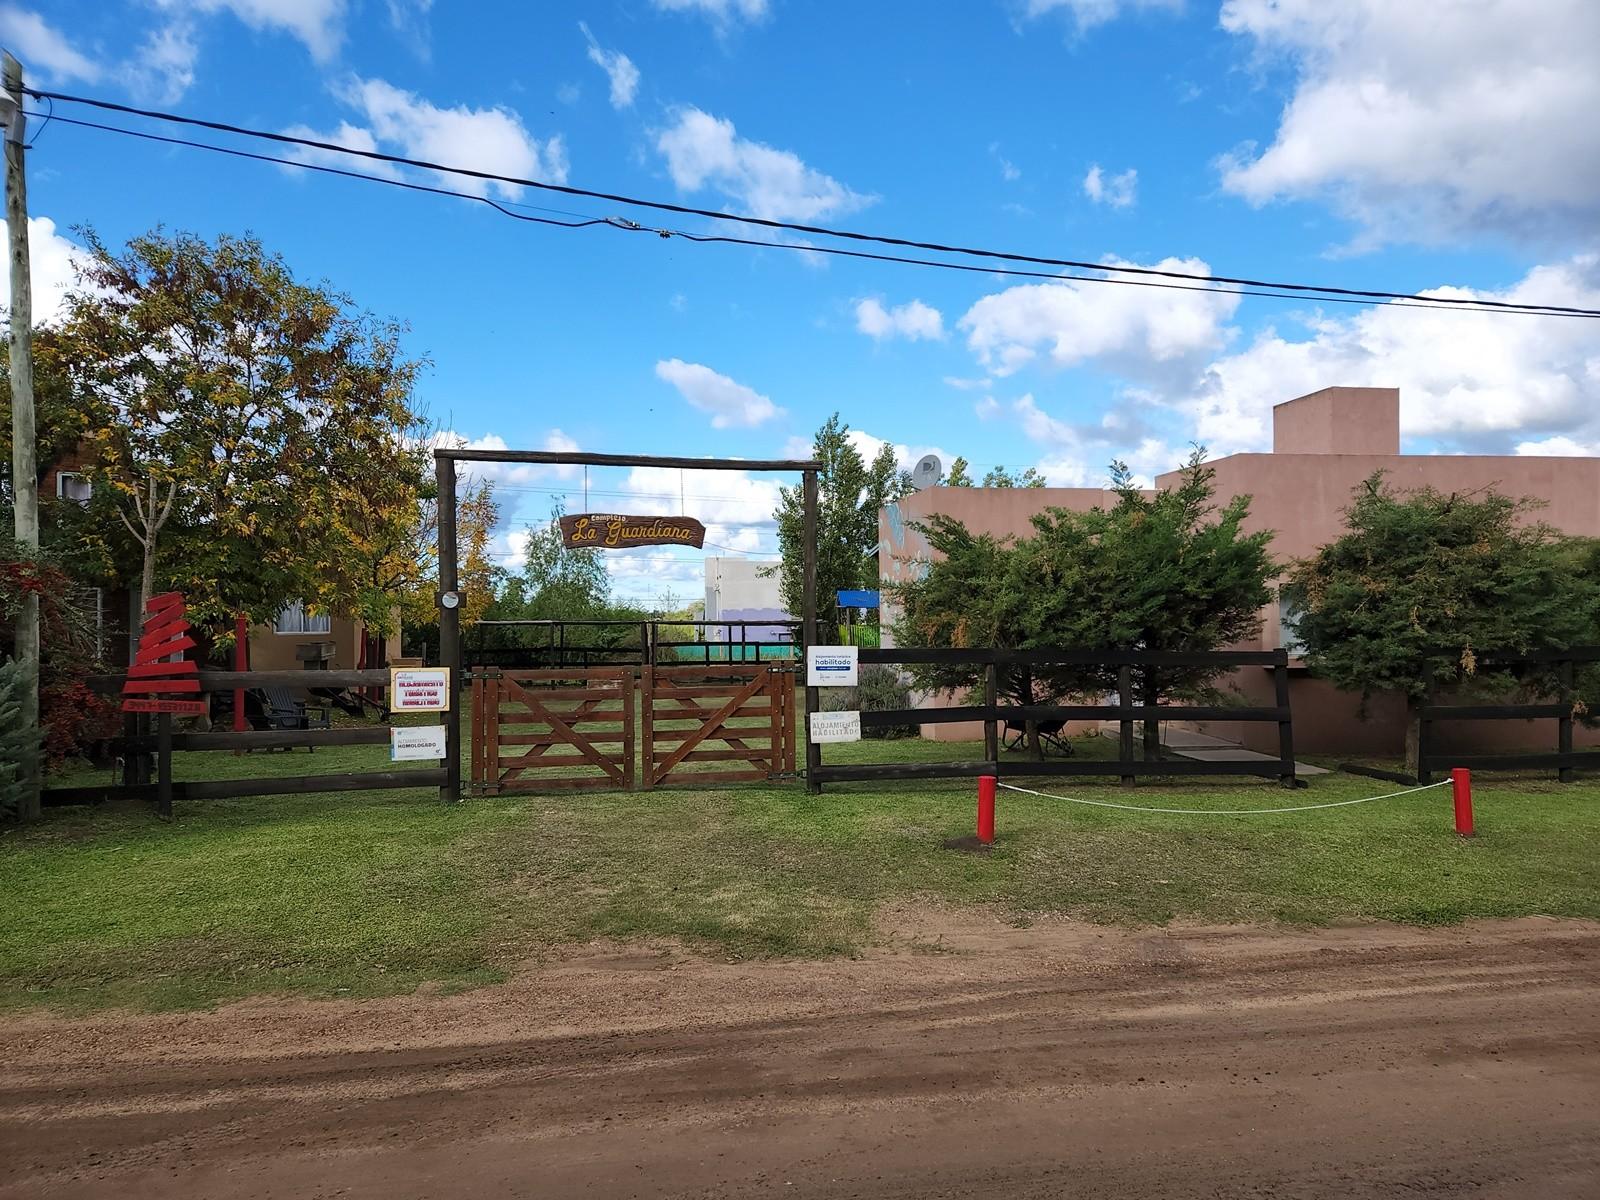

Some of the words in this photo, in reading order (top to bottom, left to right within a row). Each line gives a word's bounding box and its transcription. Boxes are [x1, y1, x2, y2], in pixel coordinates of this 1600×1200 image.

[571, 517, 597, 541] La
[605, 519, 692, 545] Guardiana
[812, 721, 859, 729] ALOJAMIENTO
